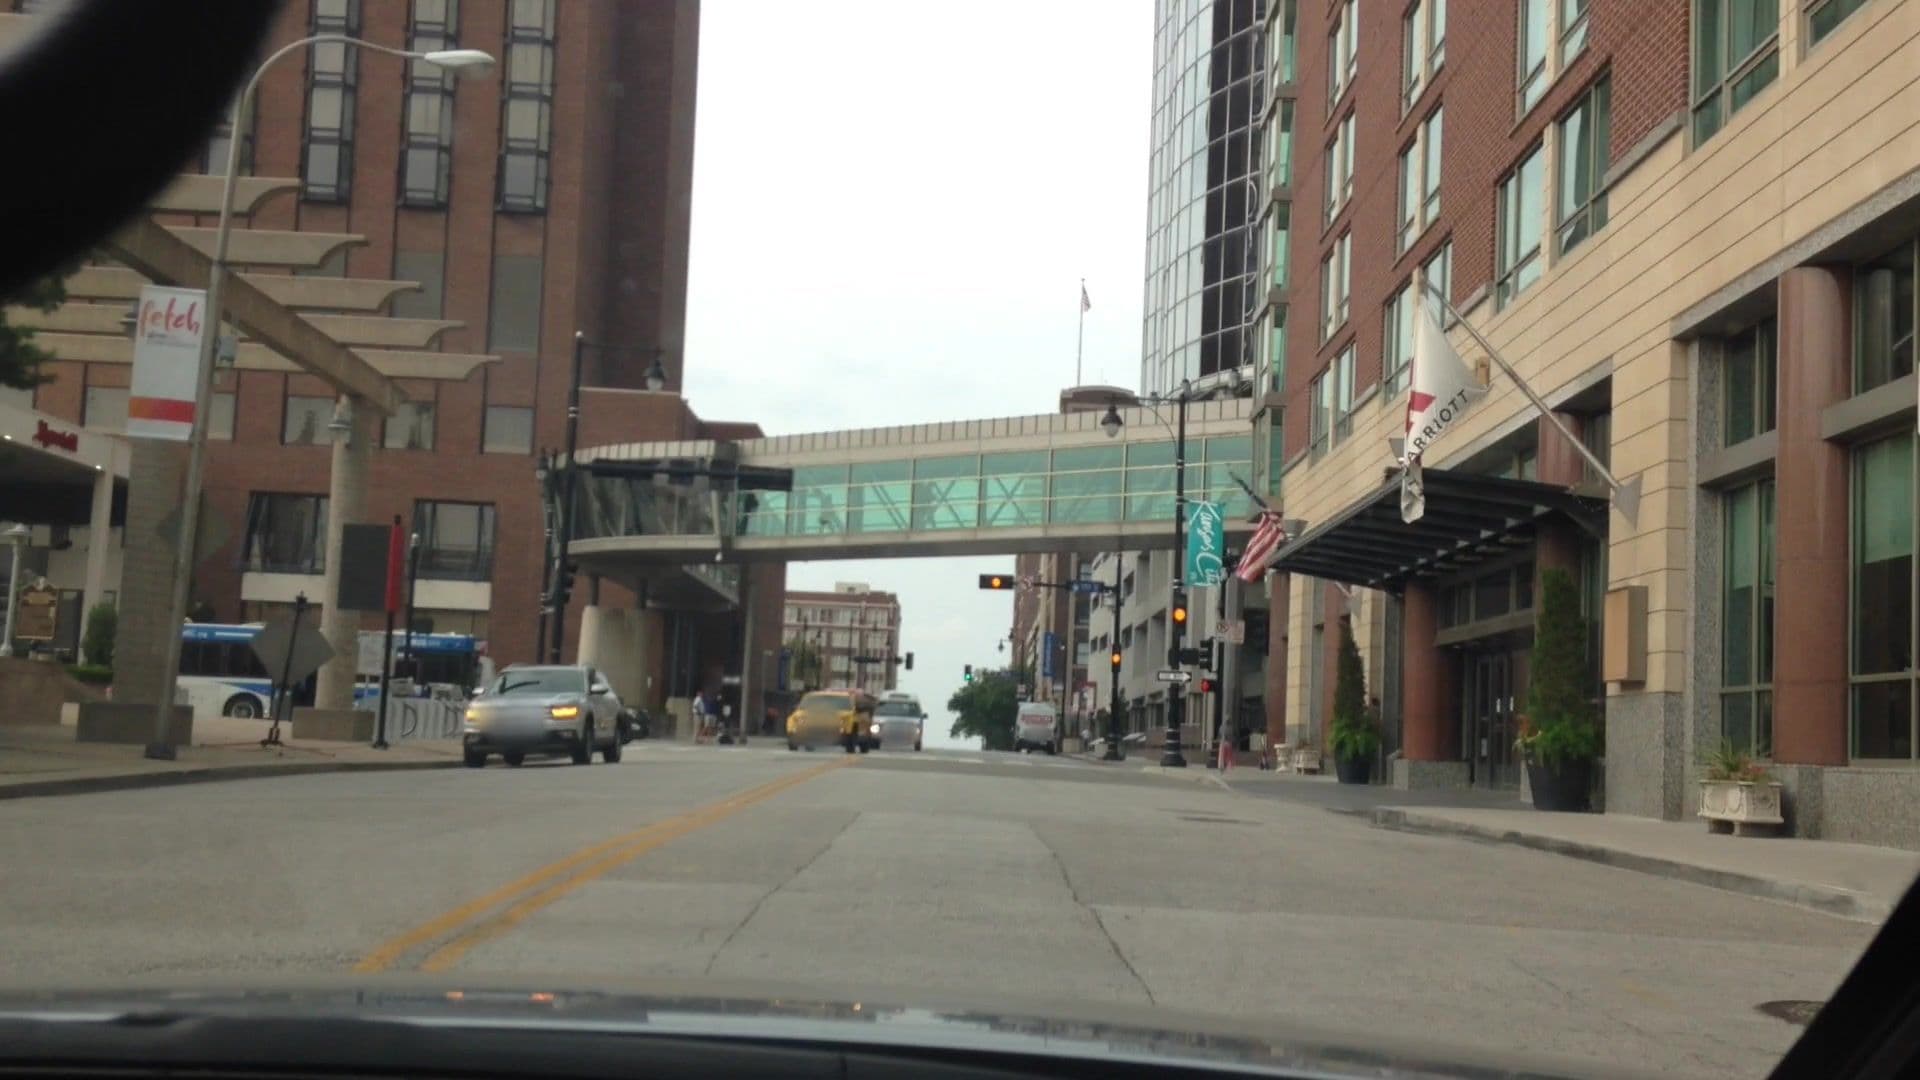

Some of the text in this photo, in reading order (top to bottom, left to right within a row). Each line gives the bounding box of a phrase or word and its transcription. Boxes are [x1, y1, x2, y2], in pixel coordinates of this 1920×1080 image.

[1403, 388, 1468, 466] ARRIOTT
[1188, 499, 1224, 587] Kansas City
